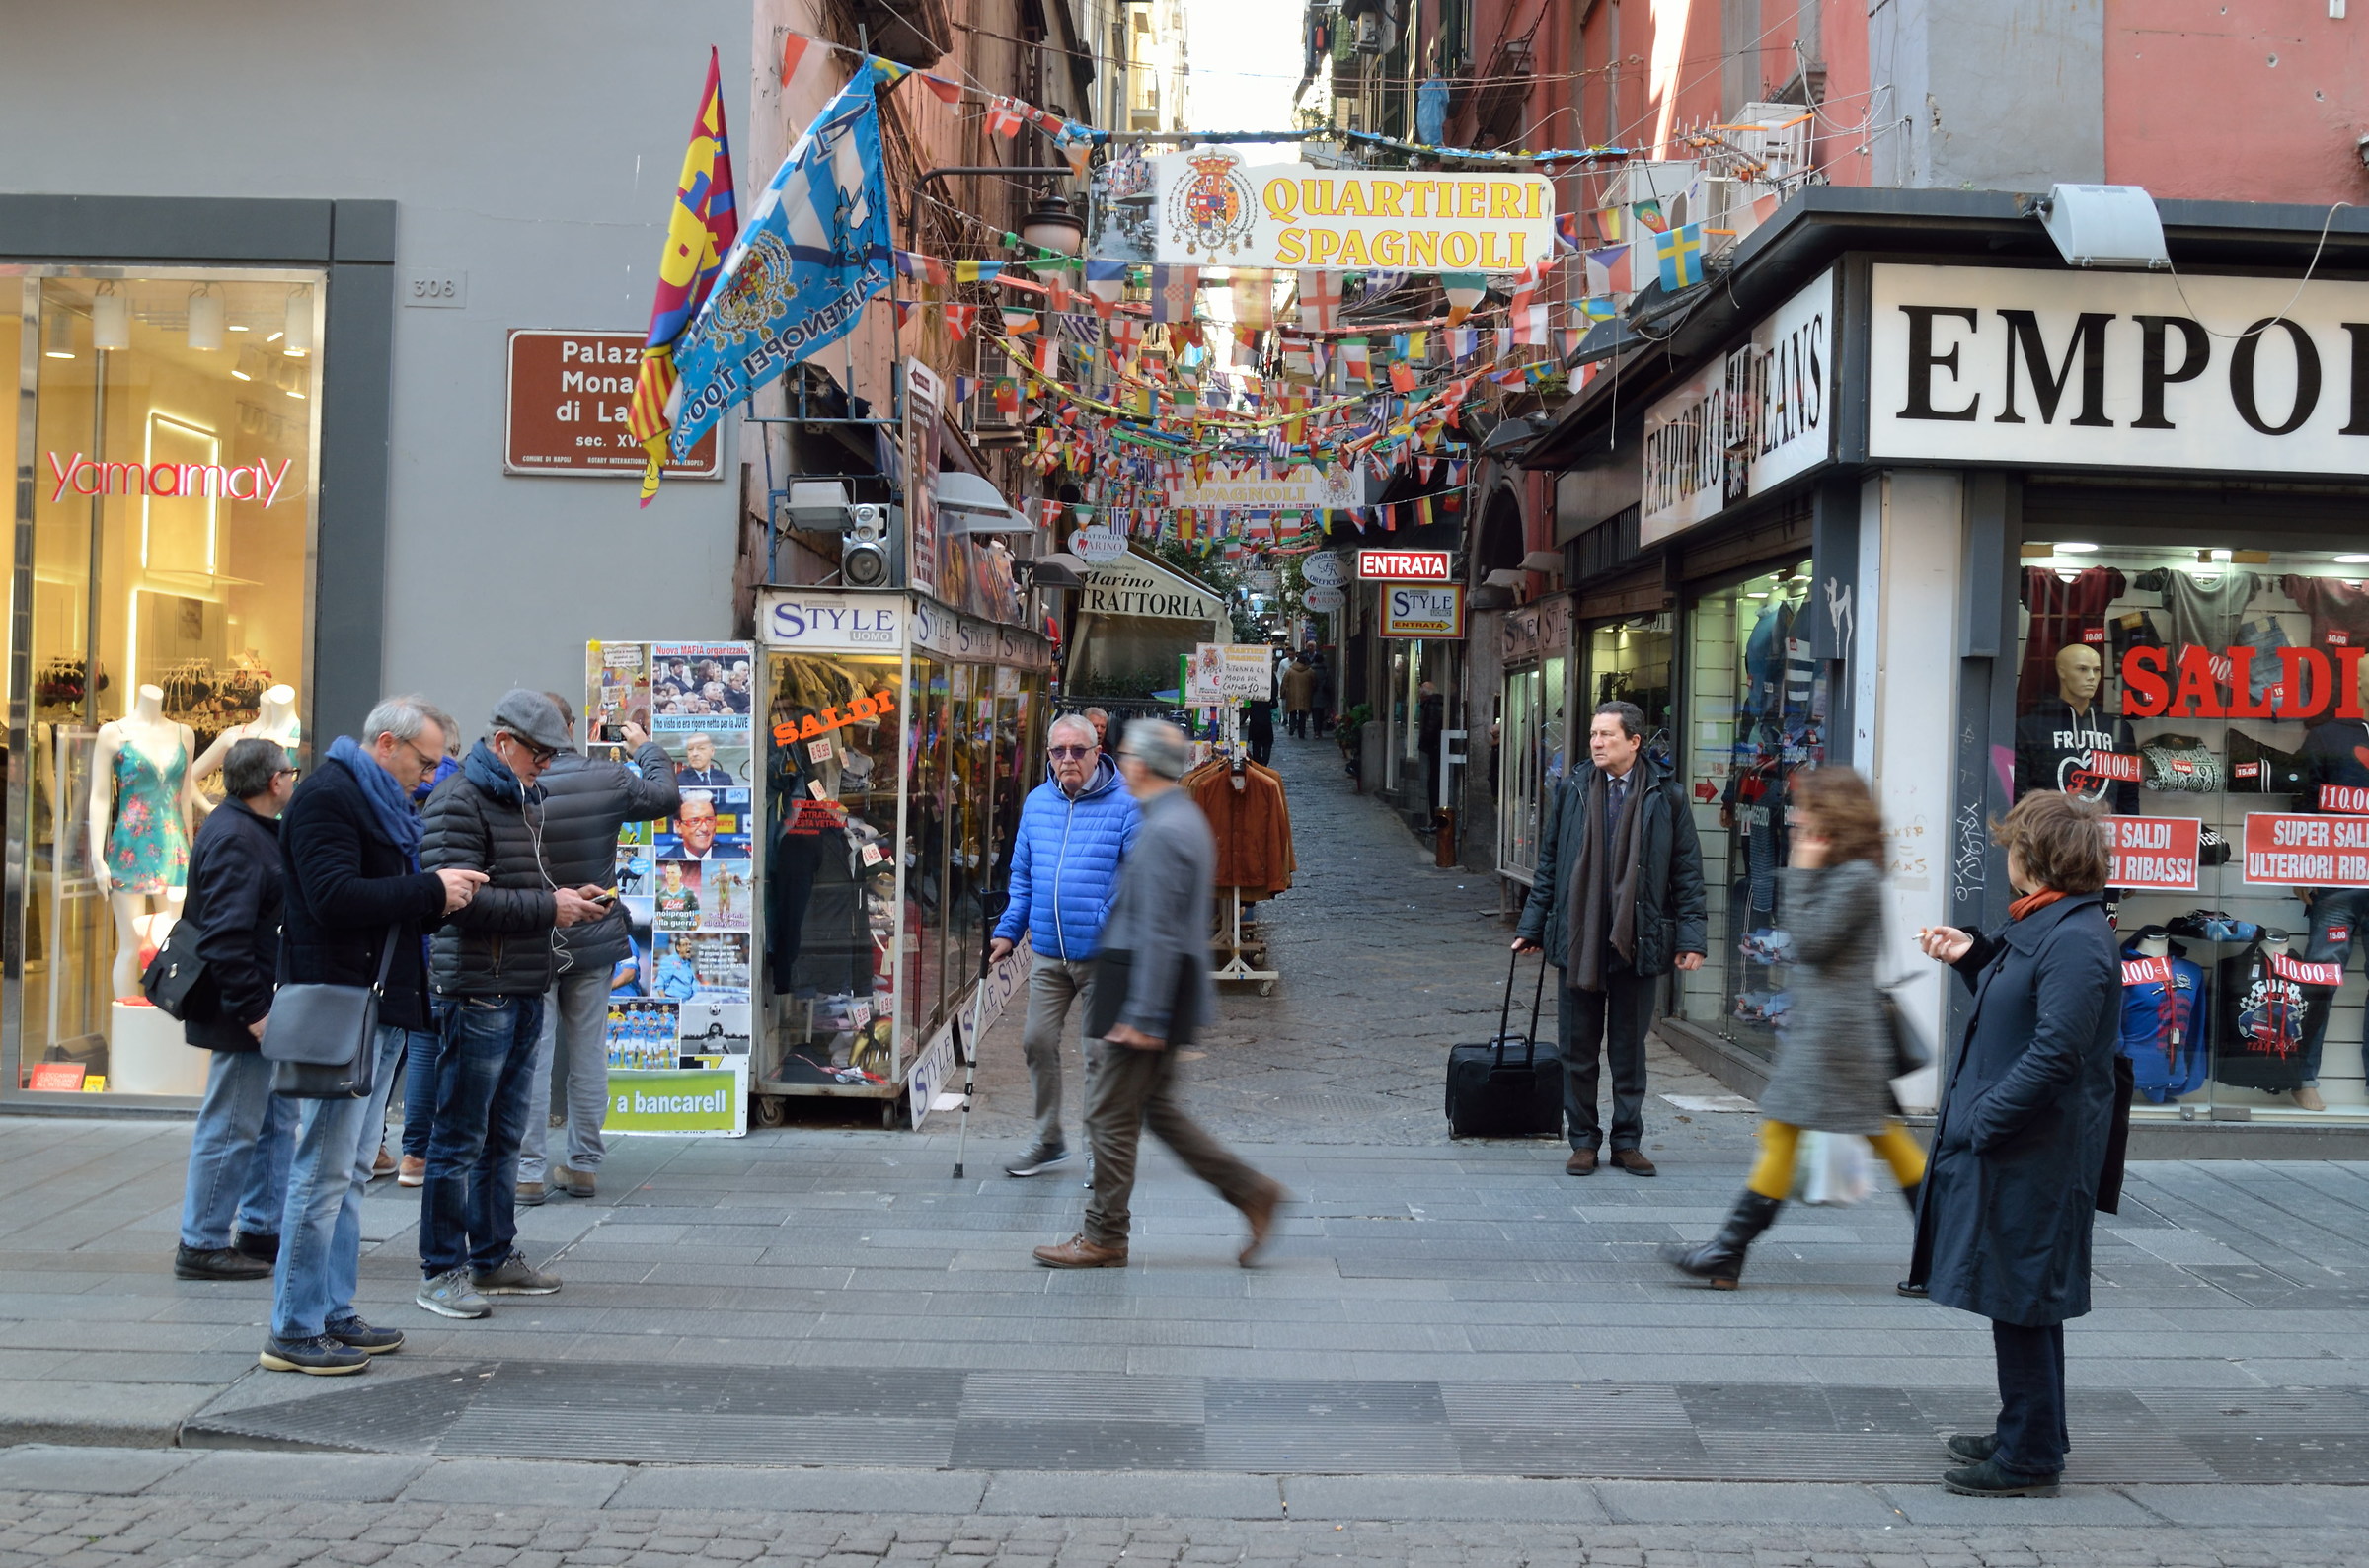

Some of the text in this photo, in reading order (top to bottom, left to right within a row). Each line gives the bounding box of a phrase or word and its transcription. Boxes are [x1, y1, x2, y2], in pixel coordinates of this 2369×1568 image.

[1262, 178, 1543, 223] QUARTIERI
[1275, 229, 1528, 269] SPAGNOLI
[414, 279, 455, 297] 308
[562, 341, 647, 364] Palazz
[561, 371, 637, 394] Mona
[556, 400, 629, 423] di La
[1645, 388, 1721, 517] EMPORIO
[1750, 312, 1824, 464] JEANS
[575, 434, 643, 448] sec. XV
[1184, 486, 1306, 503] SPAGNOLI
[1363, 555, 1446, 575] ENTRATA
[1078, 588, 1206, 618] TRATTORIA
[1393, 591, 1453, 617] STYLE
[773, 602, 896, 638] STYLE
[918, 603, 951, 641] STYLE
[852, 632, 890, 641] UOMO
[959, 626, 993, 652] STYLE
[1004, 634, 1035, 657] STYLE
[655, 645, 679, 655] Nuova
[681, 645, 704, 655] MAFIA
[1247, 683, 1259, 693] 10
[2121, 644, 2366, 719] SALDI
[691, 718, 707, 732] rigore
[721, 719, 729, 732] per
[734, 717, 748, 729] JUVE
[773, 690, 896, 747] SALDI
[2053, 730, 2113, 752] FRUTTA
[2121, 820, 2171, 850] SALDI
[2273, 819, 2369, 848] SUPER SAL
[2125, 855, 2193, 883] RIBASSI
[2249, 852, 2369, 881] ULTERIORI RIB
[914, 1035, 953, 1116] STYLE
[616, 1095, 629, 1114] a
